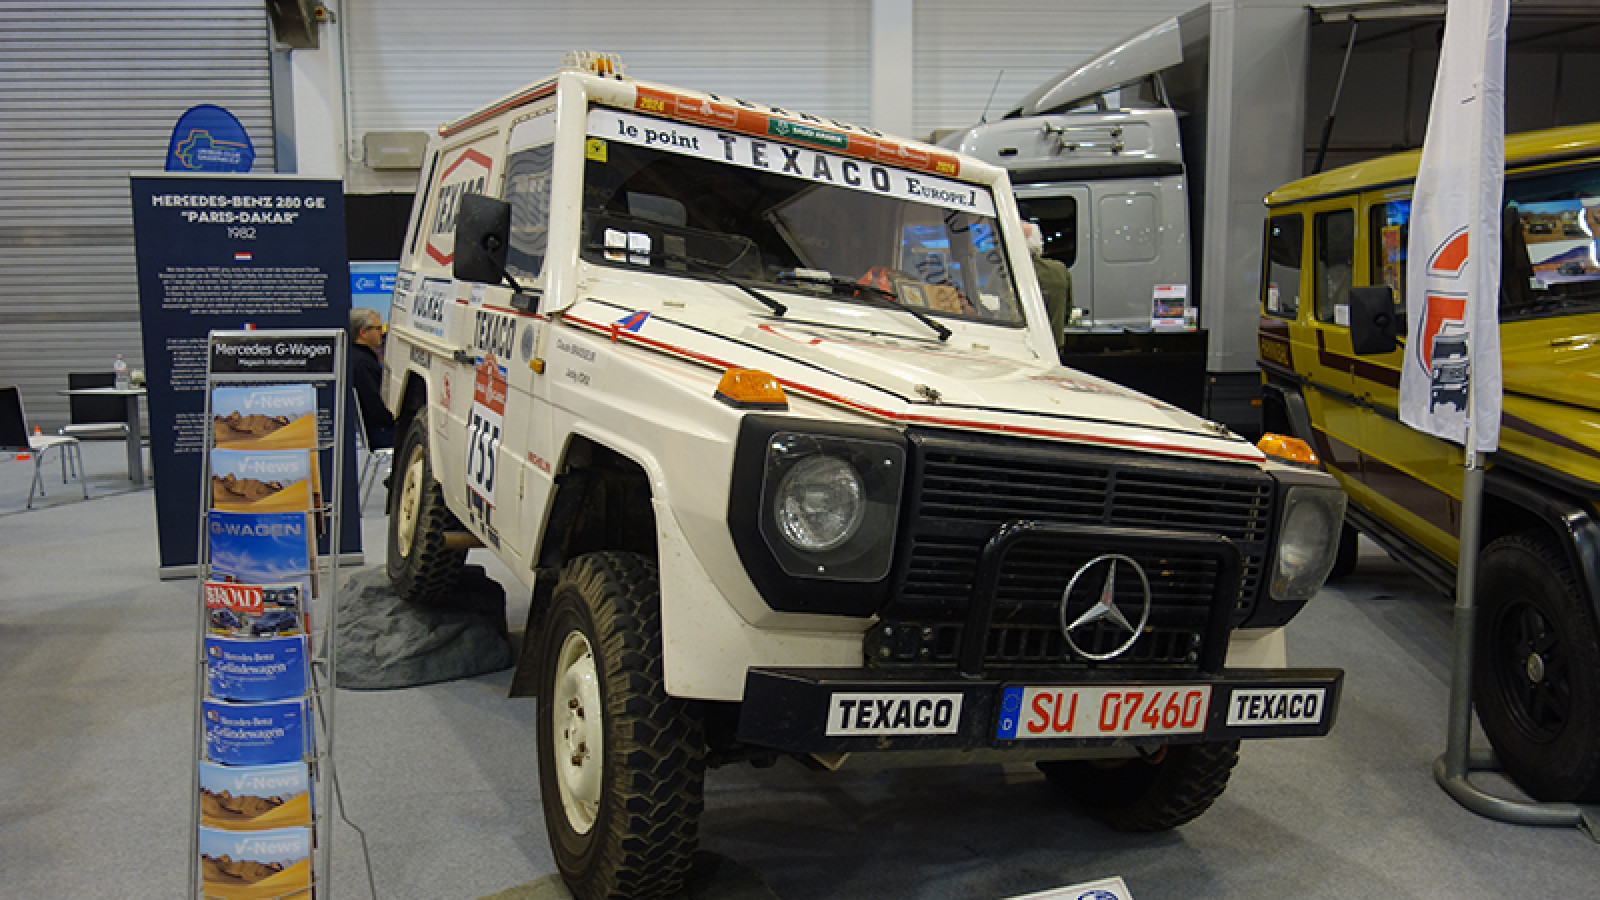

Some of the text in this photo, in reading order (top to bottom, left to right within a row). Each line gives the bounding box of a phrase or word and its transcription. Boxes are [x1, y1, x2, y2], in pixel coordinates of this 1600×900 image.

[617, 119, 639, 139] le
[644, 127, 700, 151] point
[717, 132, 891, 193] TEXACO
[152, 195, 327, 209] MERCEDES-BENZ 280 GE
[227, 226, 257, 239] 1982
[474, 310, 517, 360] TEXACO
[215, 342, 331, 358] Mercedes G-Wagen
[839, 699, 953, 729] TEXACO
[1027, 691, 1079, 733] SU
[1098, 690, 1203, 732] 07460
[1235, 694, 1318, 721] TEXACO
